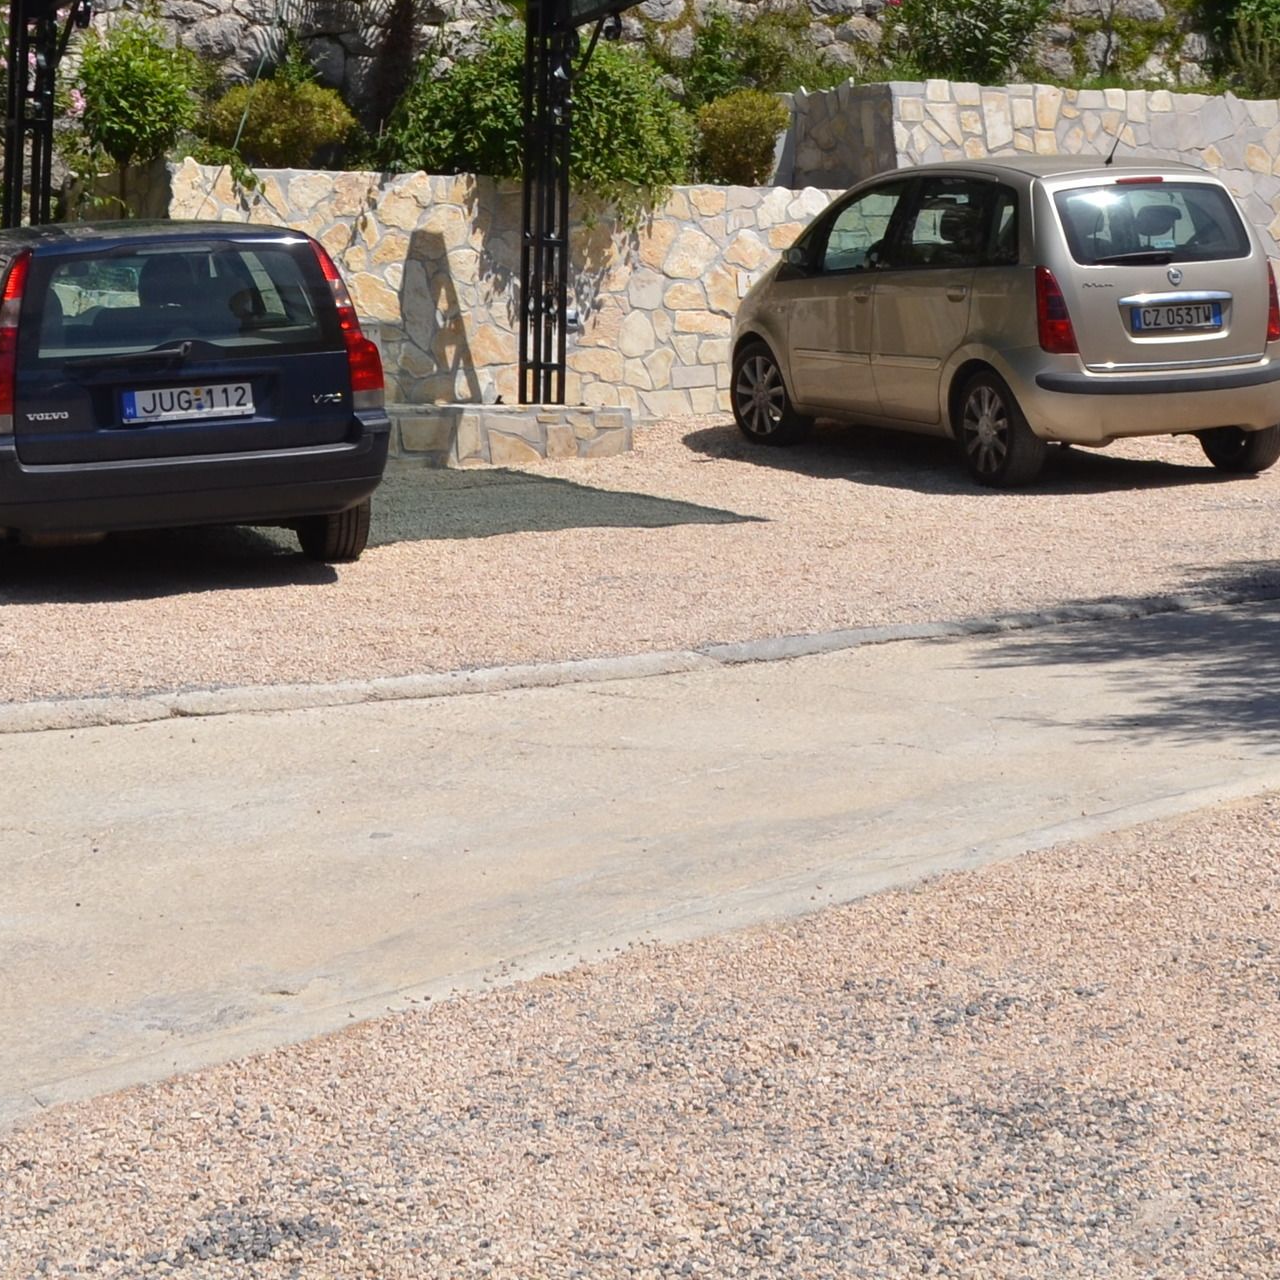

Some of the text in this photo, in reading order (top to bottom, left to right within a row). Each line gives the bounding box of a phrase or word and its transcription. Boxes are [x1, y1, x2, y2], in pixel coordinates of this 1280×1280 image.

[1142, 305, 1212, 327] CZ 053TW
[25, 411, 70, 421] VOLVO
[126, 407, 134, 416] H
